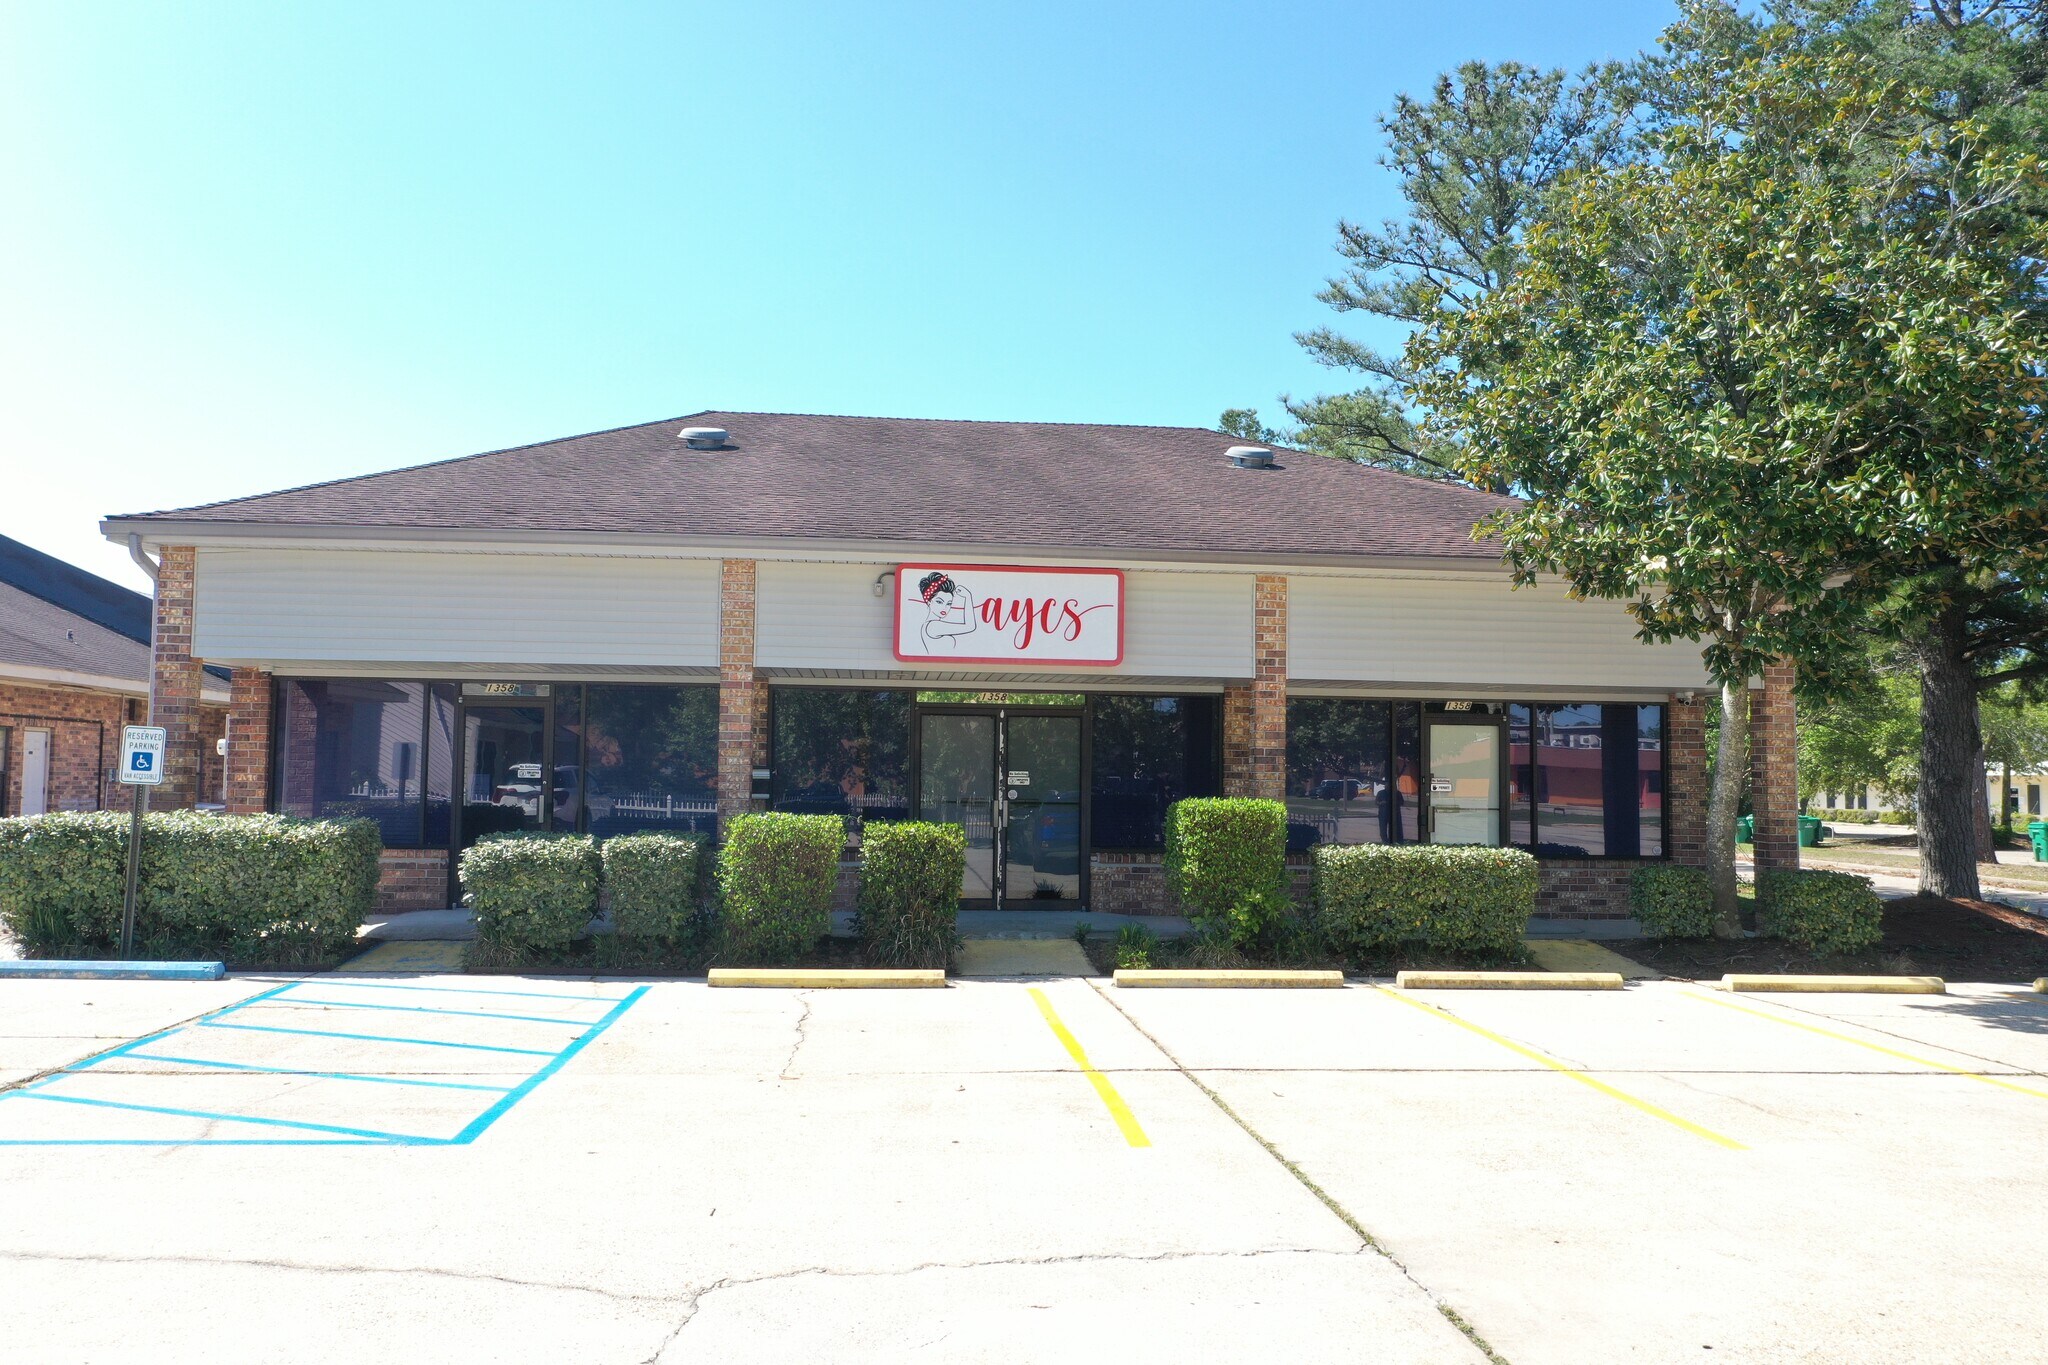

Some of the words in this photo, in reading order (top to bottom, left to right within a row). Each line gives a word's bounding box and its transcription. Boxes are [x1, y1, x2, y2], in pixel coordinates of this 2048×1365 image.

[487, 683, 515, 692] 1358
[981, 692, 1008, 701] 1358
[1447, 701, 1472, 710] 1358
[127, 731, 163, 741] RESERVED
[128, 742, 159, 751] PARKING
